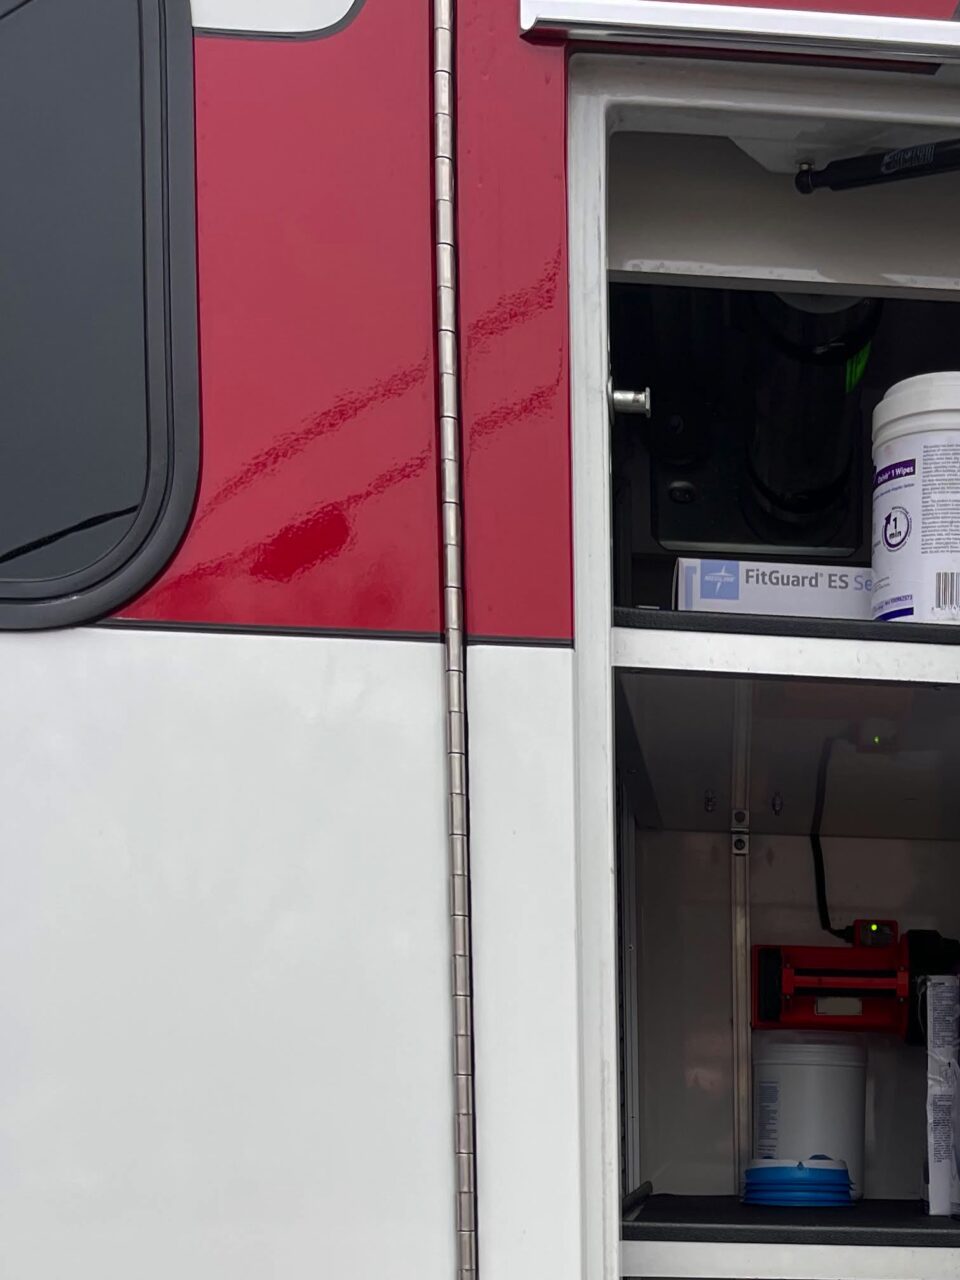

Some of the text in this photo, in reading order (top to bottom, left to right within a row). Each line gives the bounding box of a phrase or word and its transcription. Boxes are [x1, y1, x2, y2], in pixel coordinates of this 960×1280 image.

[892, 516, 898, 529] 1
[889, 530, 902, 540] min
[827, 572, 849, 589] ES
